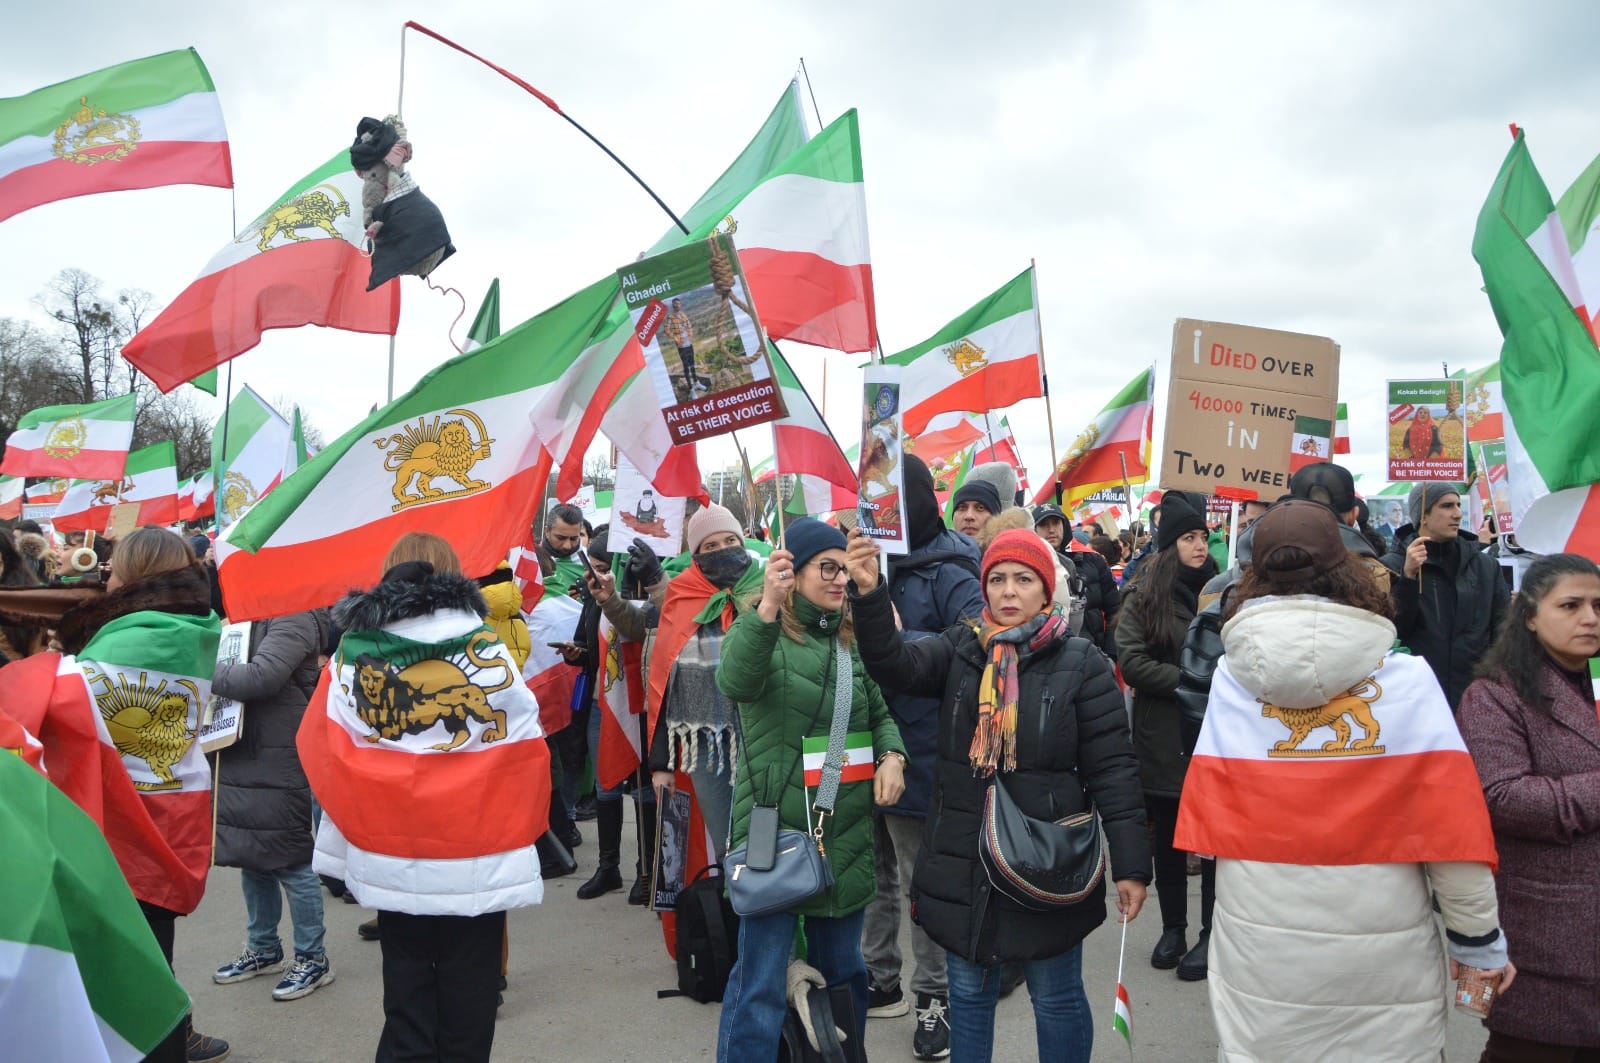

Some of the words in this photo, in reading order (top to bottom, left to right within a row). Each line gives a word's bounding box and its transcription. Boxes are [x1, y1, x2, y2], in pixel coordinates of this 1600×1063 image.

[622, 273, 637, 289] Ali
[626, 280, 671, 303] Ghaderi
[638, 304, 662, 340] Detained
[1261, 356, 1314, 377] OVER
[667, 411, 680, 423] At
[681, 404, 702, 419] risk
[703, 399, 715, 413] of
[716, 385, 774, 409] execution
[678, 423, 695, 436] BE
[695, 413, 732, 431] THEIR
[732, 401, 772, 421] VOICE
[1395, 469, 1407, 477] BE
[1408, 469, 1432, 477] THEIR
[1433, 469, 1458, 477] VOICE
